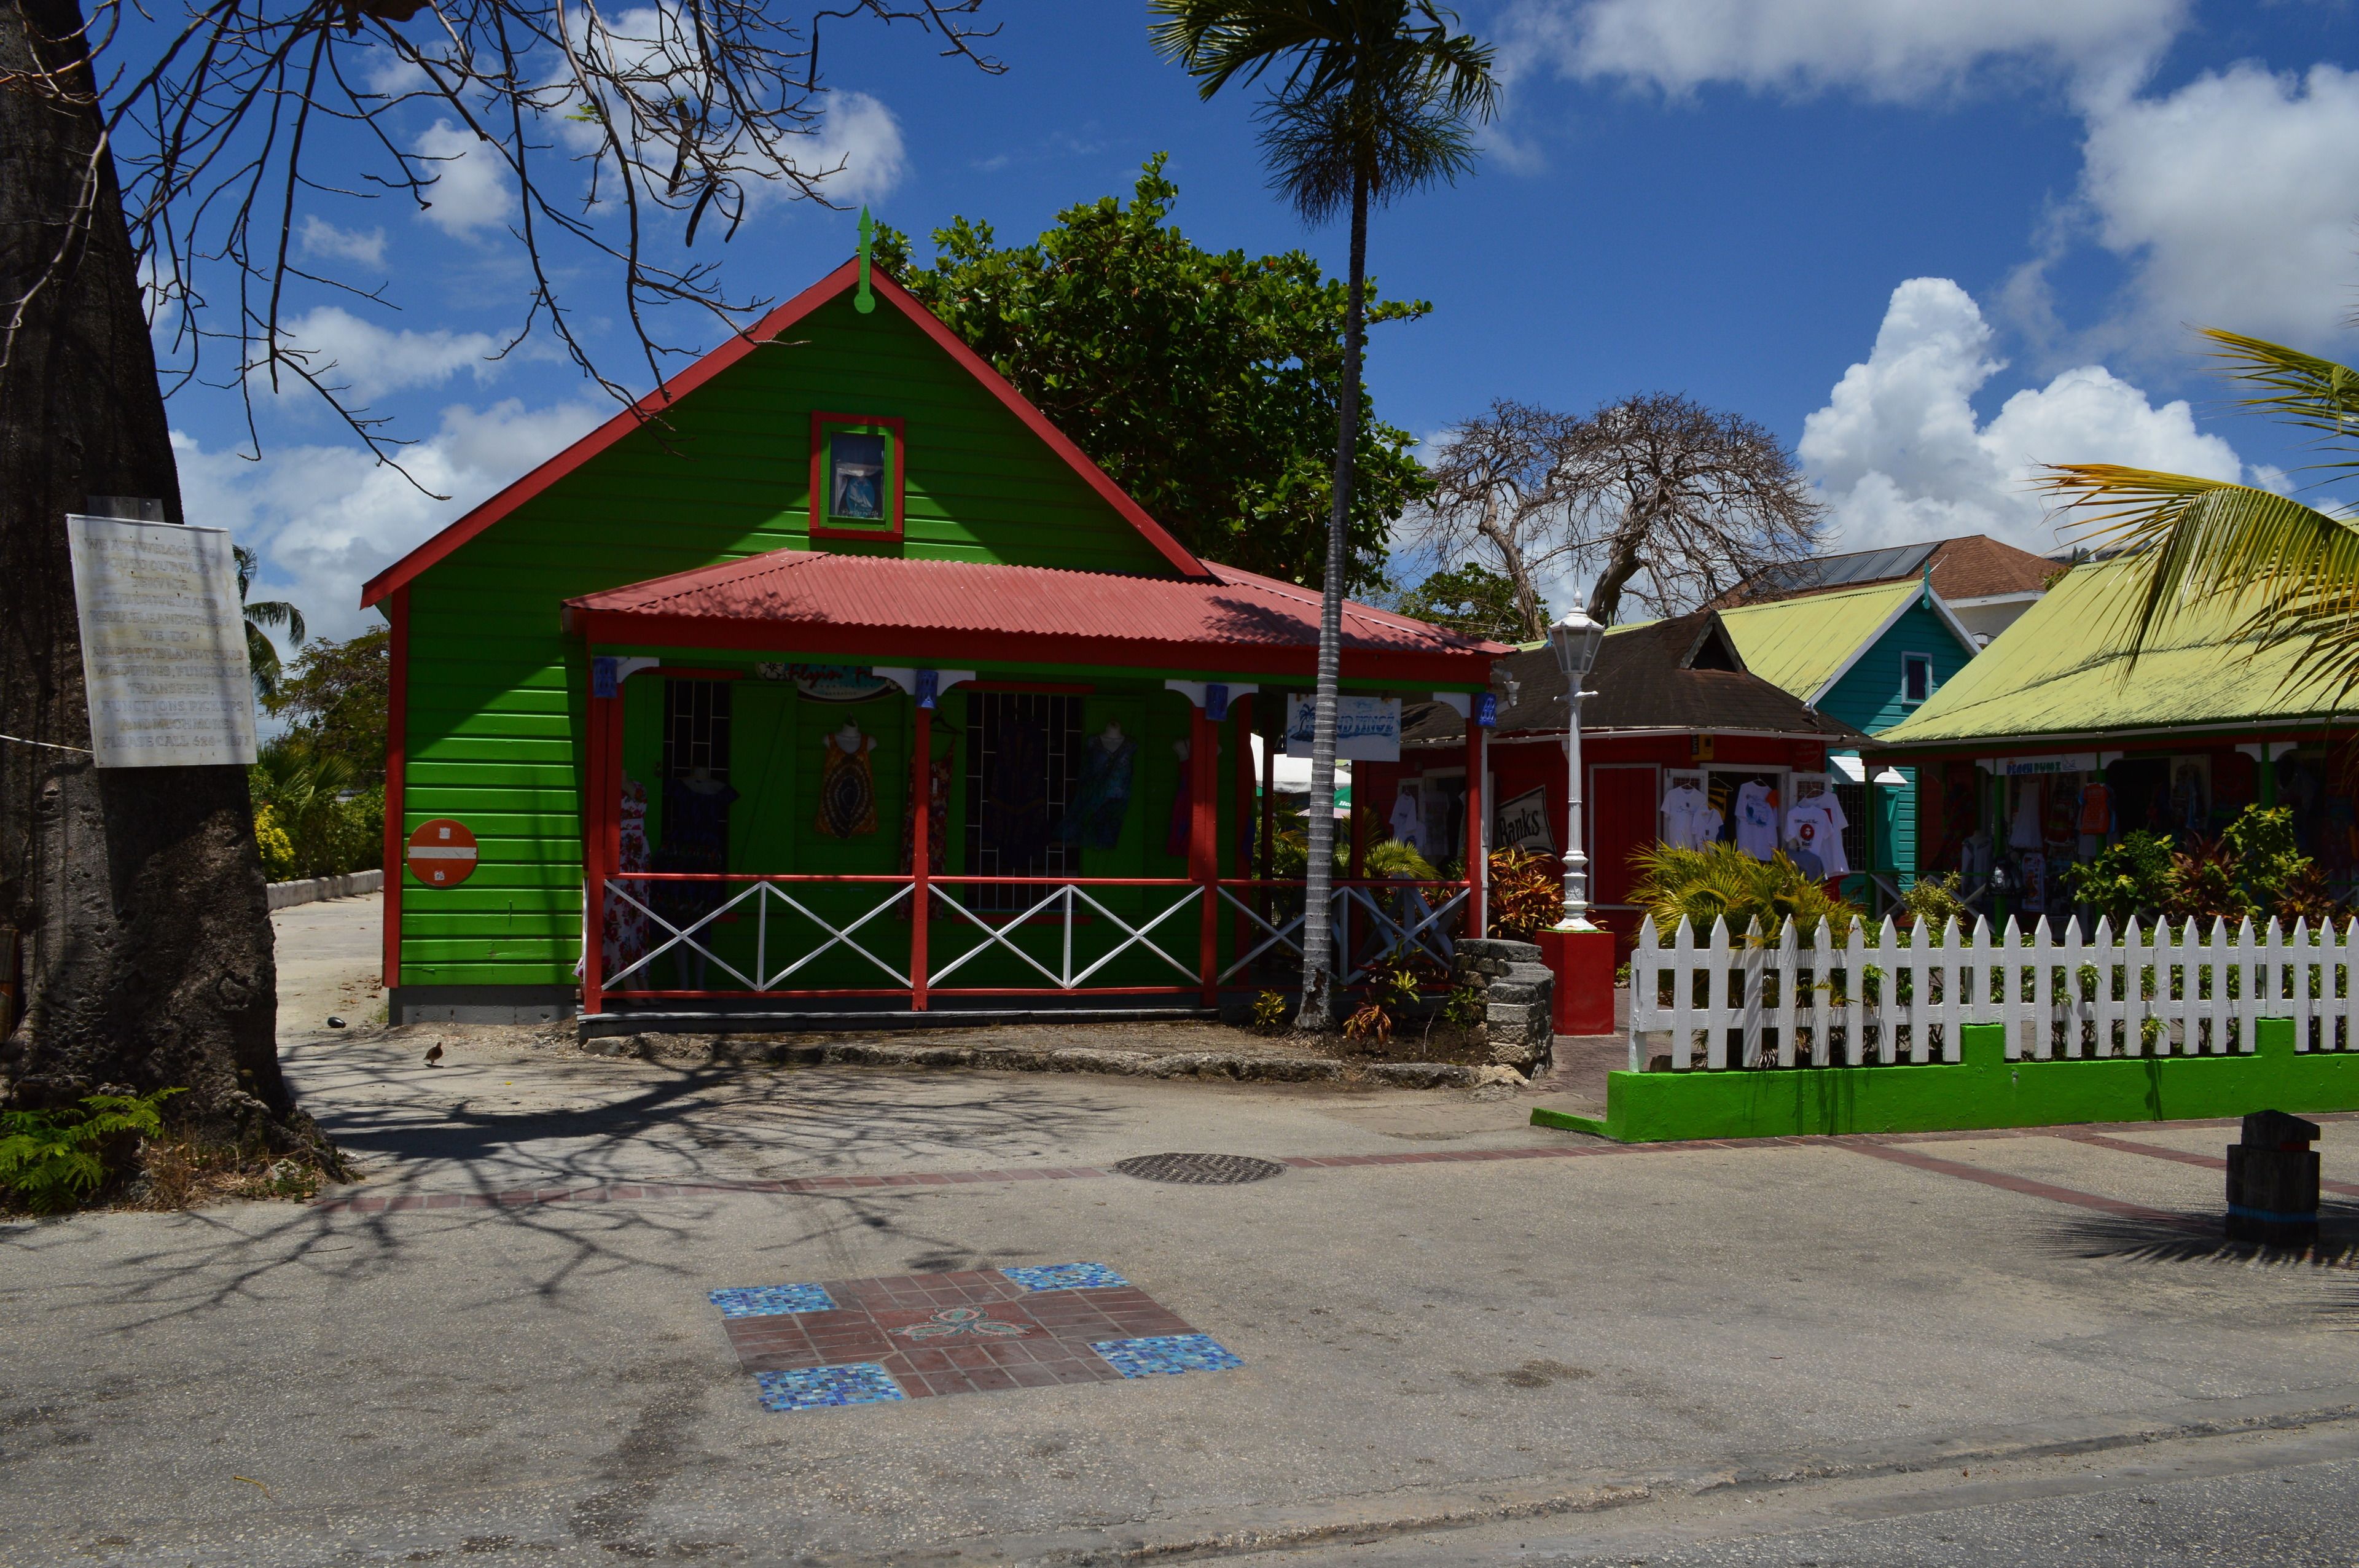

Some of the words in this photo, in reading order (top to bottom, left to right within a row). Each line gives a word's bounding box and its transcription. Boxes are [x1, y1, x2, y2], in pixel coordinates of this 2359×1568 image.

[84, 538, 108, 550] WE
[139, 630, 163, 642] WE
[169, 631, 190, 643] DO
[102, 736, 154, 749] PLEASE
[155, 736, 189, 748] CALL
[1498, 808, 1541, 847] Banks
